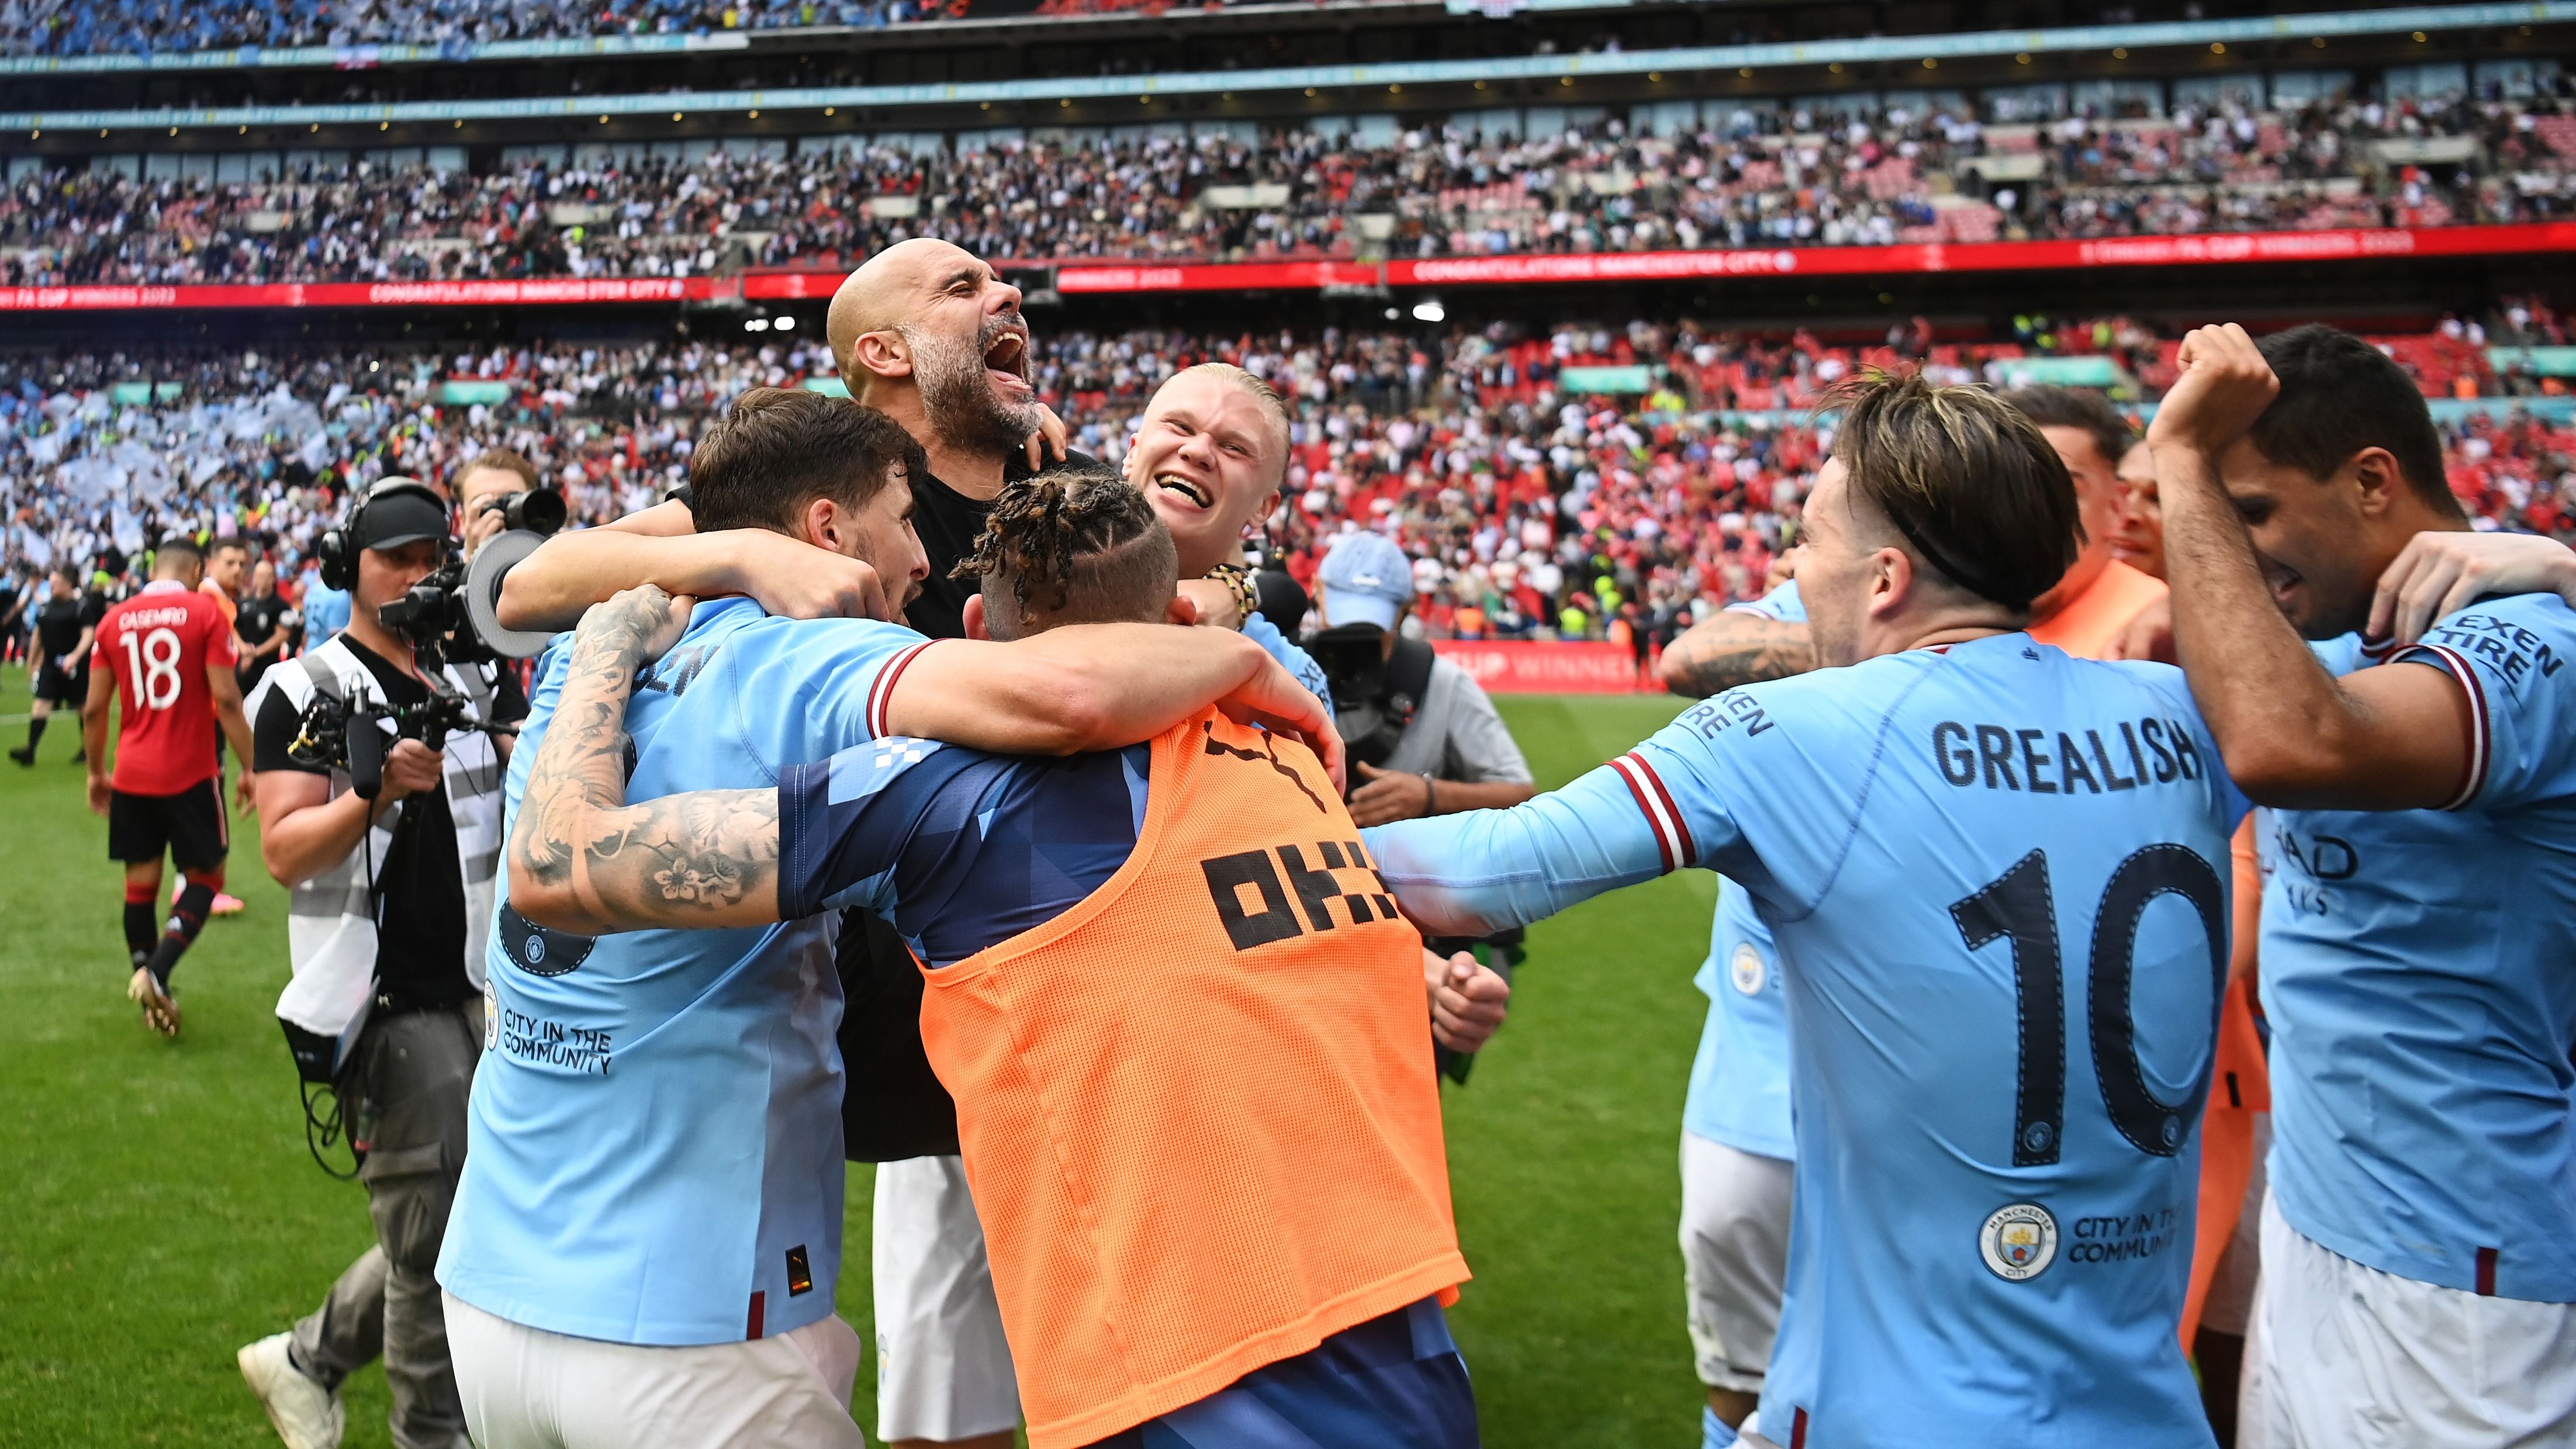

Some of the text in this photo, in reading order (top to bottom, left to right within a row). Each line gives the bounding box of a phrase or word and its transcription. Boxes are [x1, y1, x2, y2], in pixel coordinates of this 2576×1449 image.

[369, 279, 669, 303] CONGRATULATIONS MANCHESTER CITY
[119, 627, 181, 711] 18
[2439, 630, 2530, 684] TIRE
[1932, 717, 2202, 795] GREALISH
[1949, 842, 2232, 1167] 10
[504, 1008, 612, 1054] CITY IN THE
[504, 1032, 613, 1075] COMMUNITY
[2074, 1216, 2129, 1239] CITY
[2132, 1213, 2155, 1234] IN
[2006, 1268, 2031, 1278] CITY
